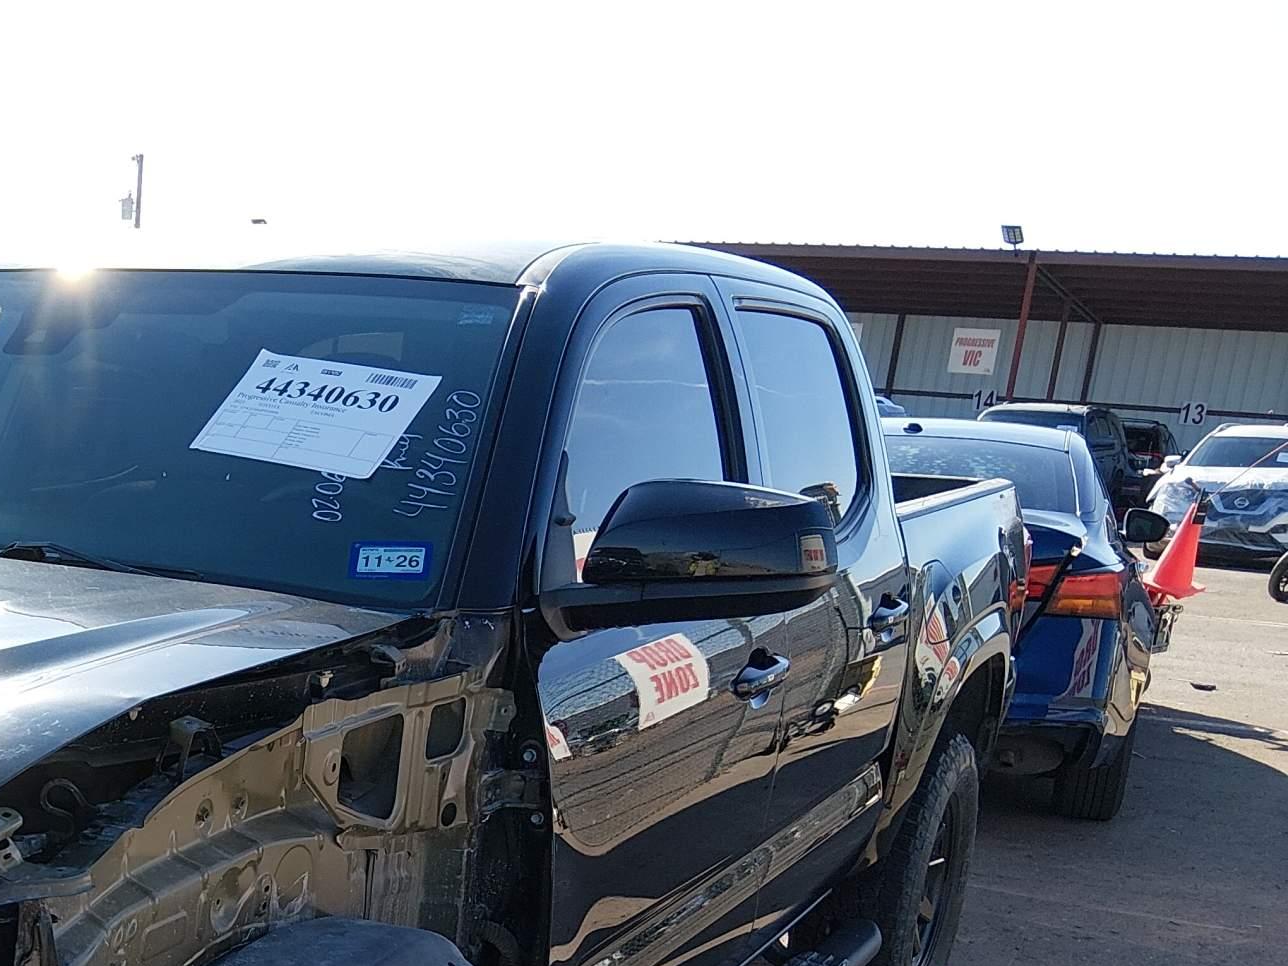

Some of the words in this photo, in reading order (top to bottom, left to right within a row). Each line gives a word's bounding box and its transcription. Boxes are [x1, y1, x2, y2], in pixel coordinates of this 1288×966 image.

[954, 336, 997, 349] PROGRESSIVE
[962, 350, 983, 368] VIC
[254, 376, 401, 413] 44340630
[974, 390, 995, 410] 14
[1182, 402, 1205, 425] 13
[392, 389, 482, 519] 44340630
